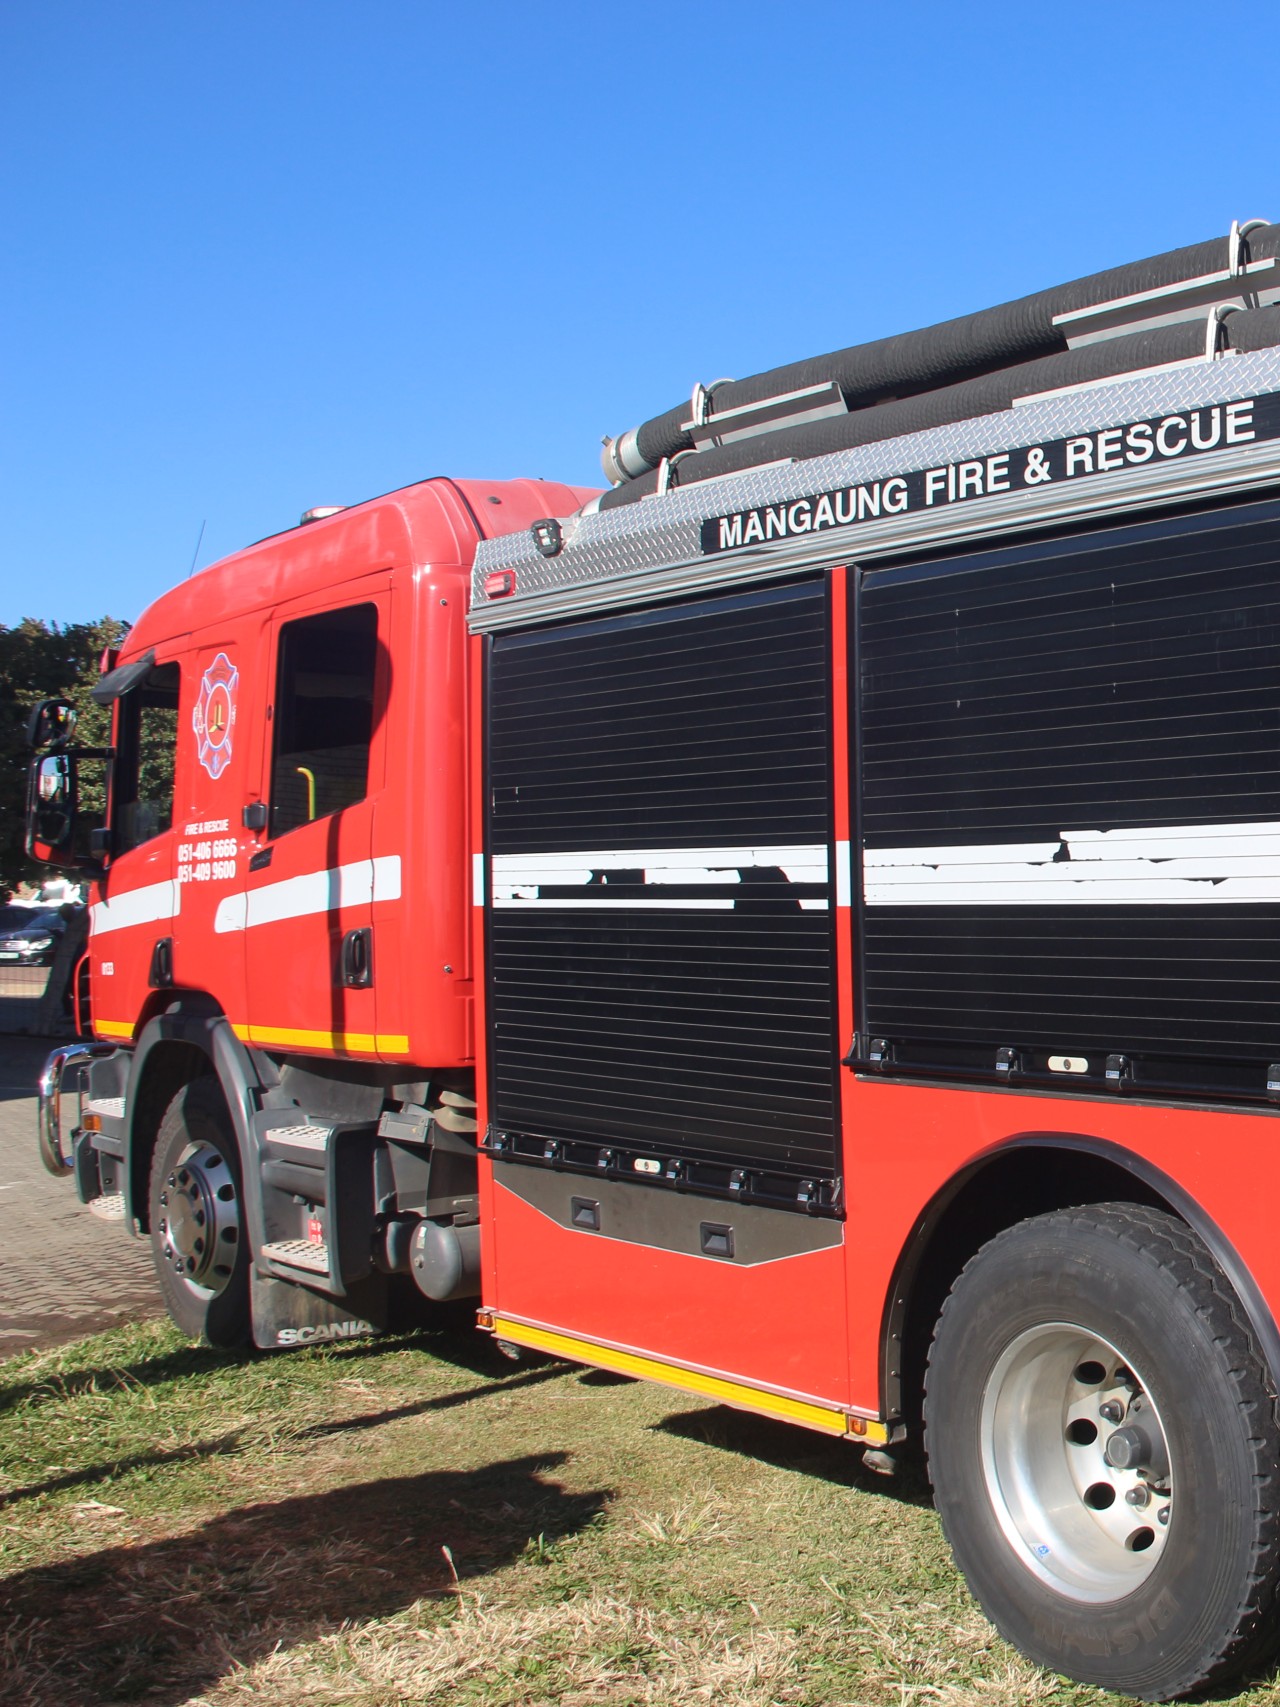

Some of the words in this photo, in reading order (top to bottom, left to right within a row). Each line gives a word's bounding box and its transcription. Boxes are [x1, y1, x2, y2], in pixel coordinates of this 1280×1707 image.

[719, 478, 908, 549] MANGAUNG
[925, 461, 1010, 503] FIRE
[1024, 448, 1051, 484] &
[1066, 401, 1255, 472] RESCUE
[184, 822, 199, 835] FIRE
[204, 819, 229, 833] RESCUE
[178, 841, 212, 862] 051-406
[213, 838, 238, 859] 6666
[178, 862, 211, 883] 051-409
[212, 860, 236, 880] 9600
[278, 1319, 373, 1345] SCANIA
